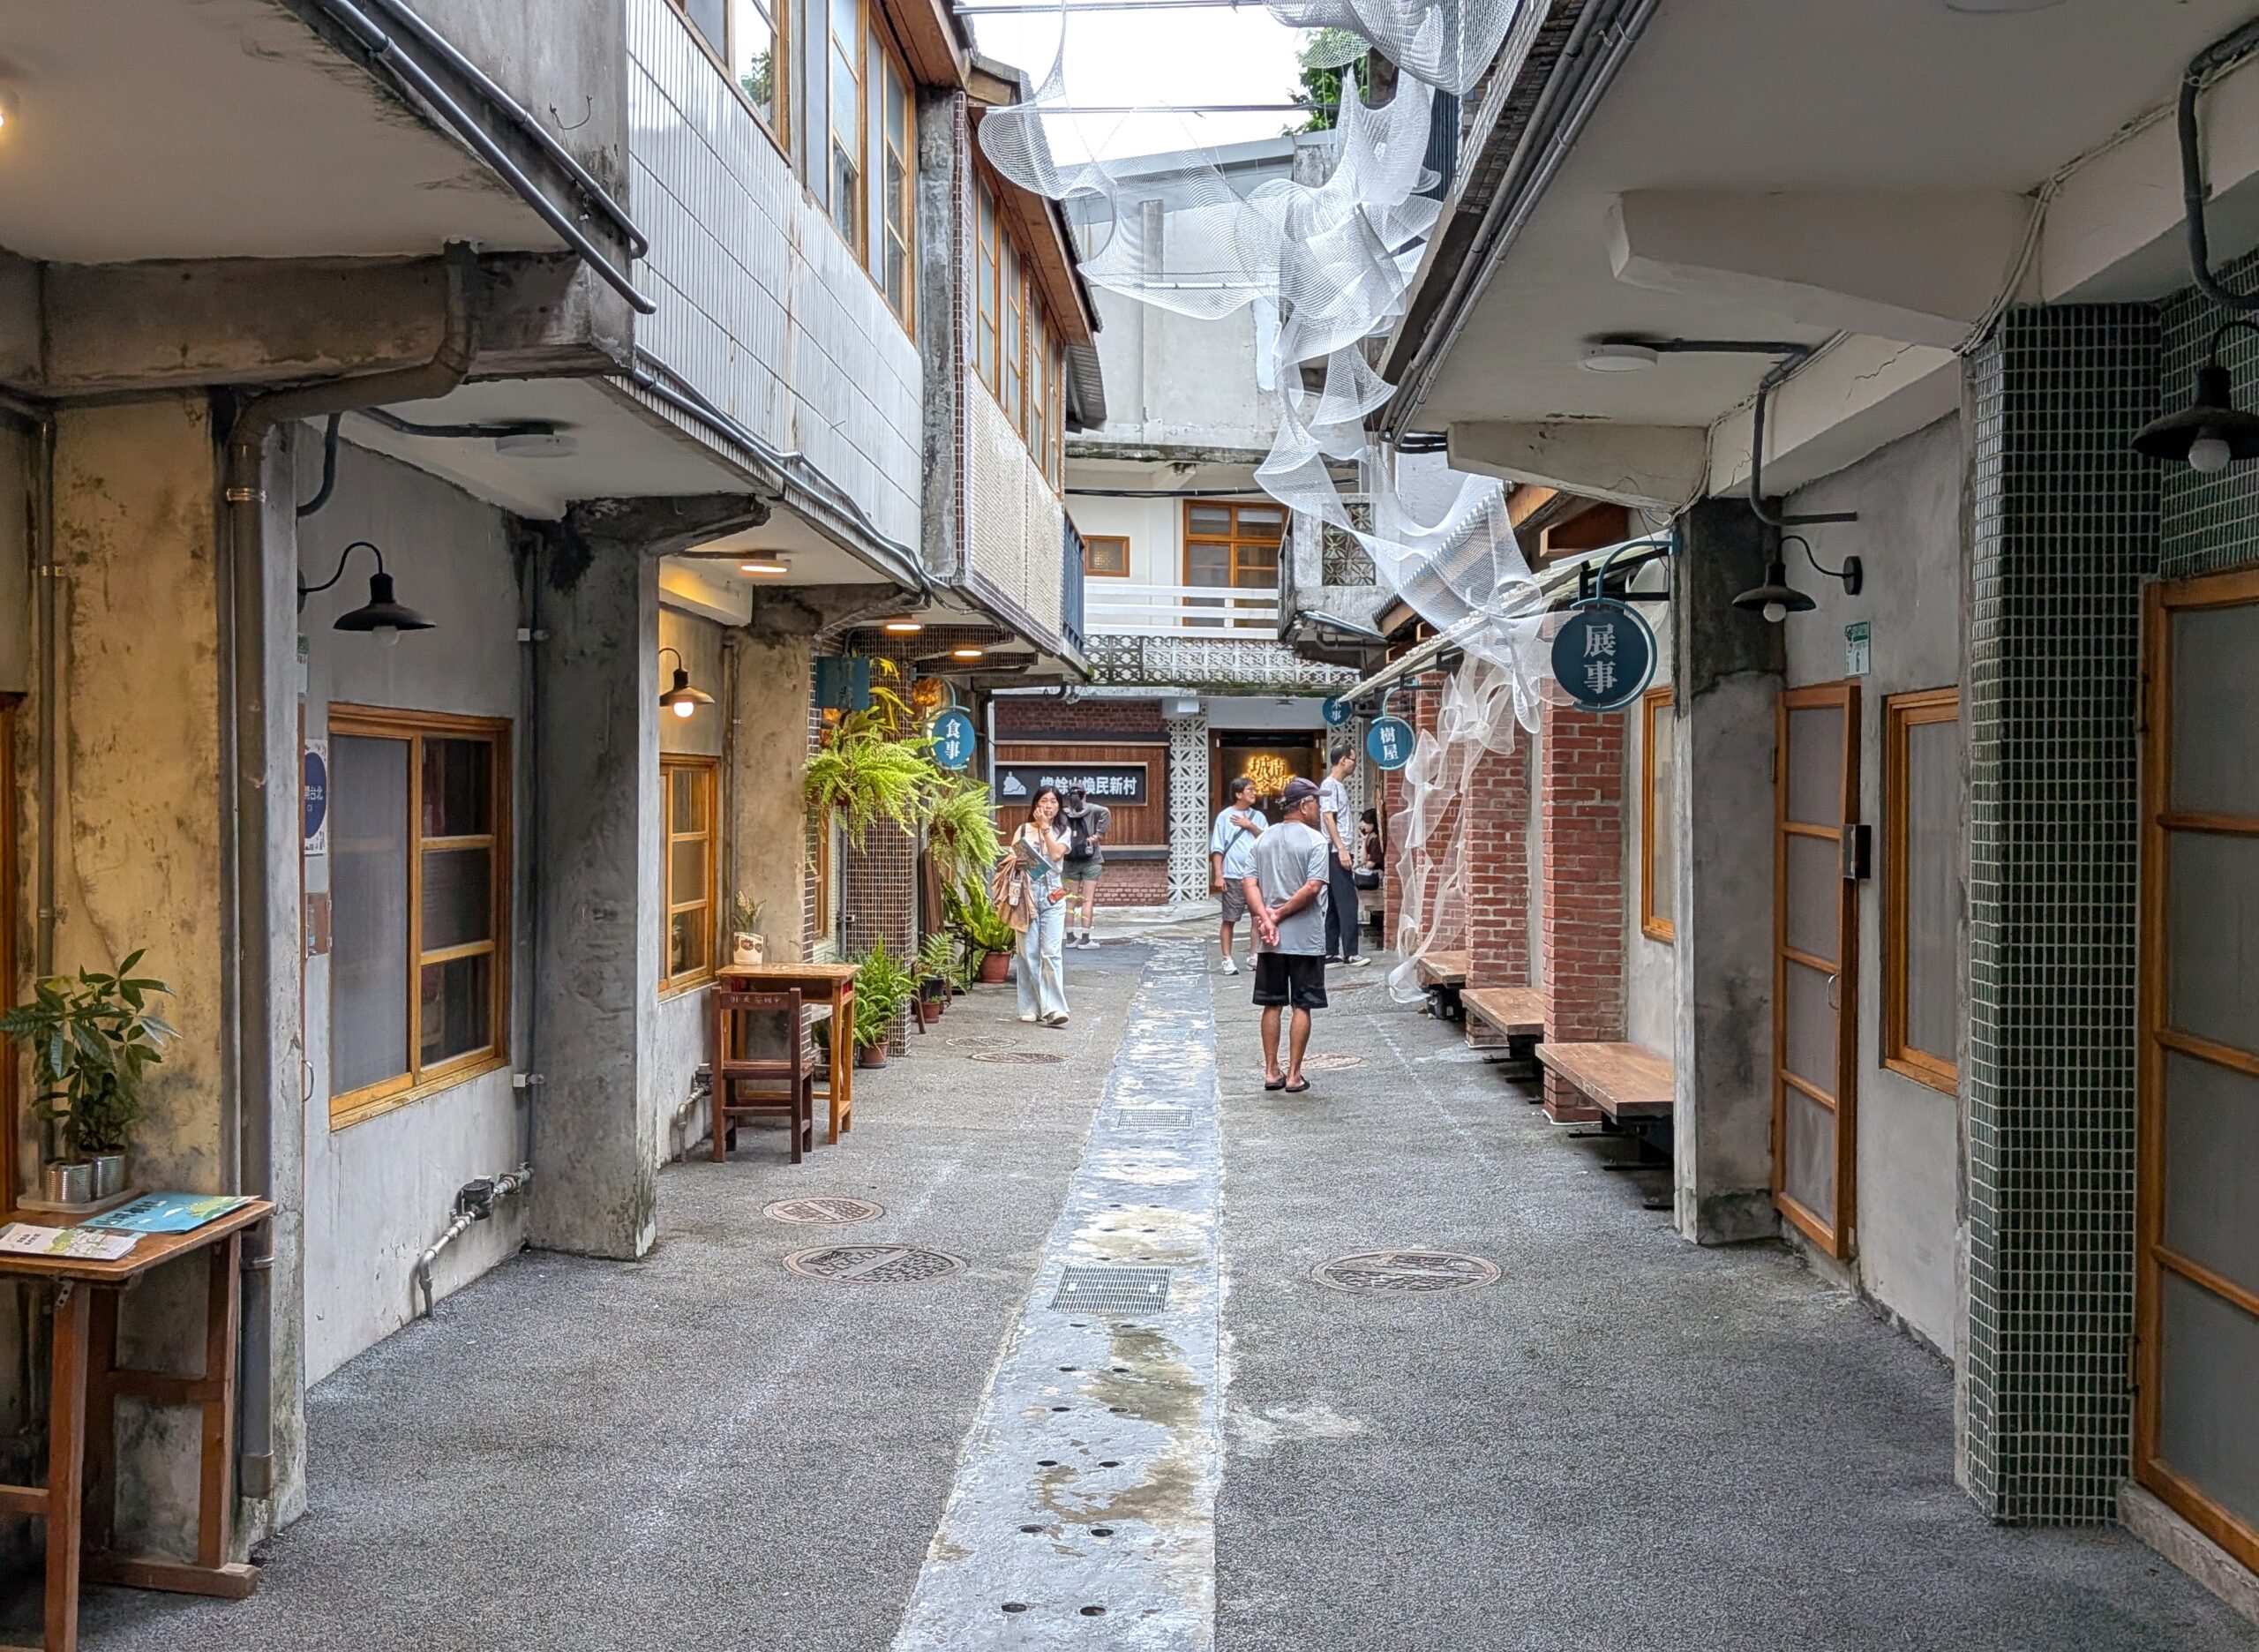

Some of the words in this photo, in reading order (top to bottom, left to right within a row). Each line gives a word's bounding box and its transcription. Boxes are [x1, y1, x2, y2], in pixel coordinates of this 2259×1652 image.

[1583, 623, 1617, 694] 展事
[945, 718, 962, 760] 食事
[1380, 726, 1399, 761] 樹屋
